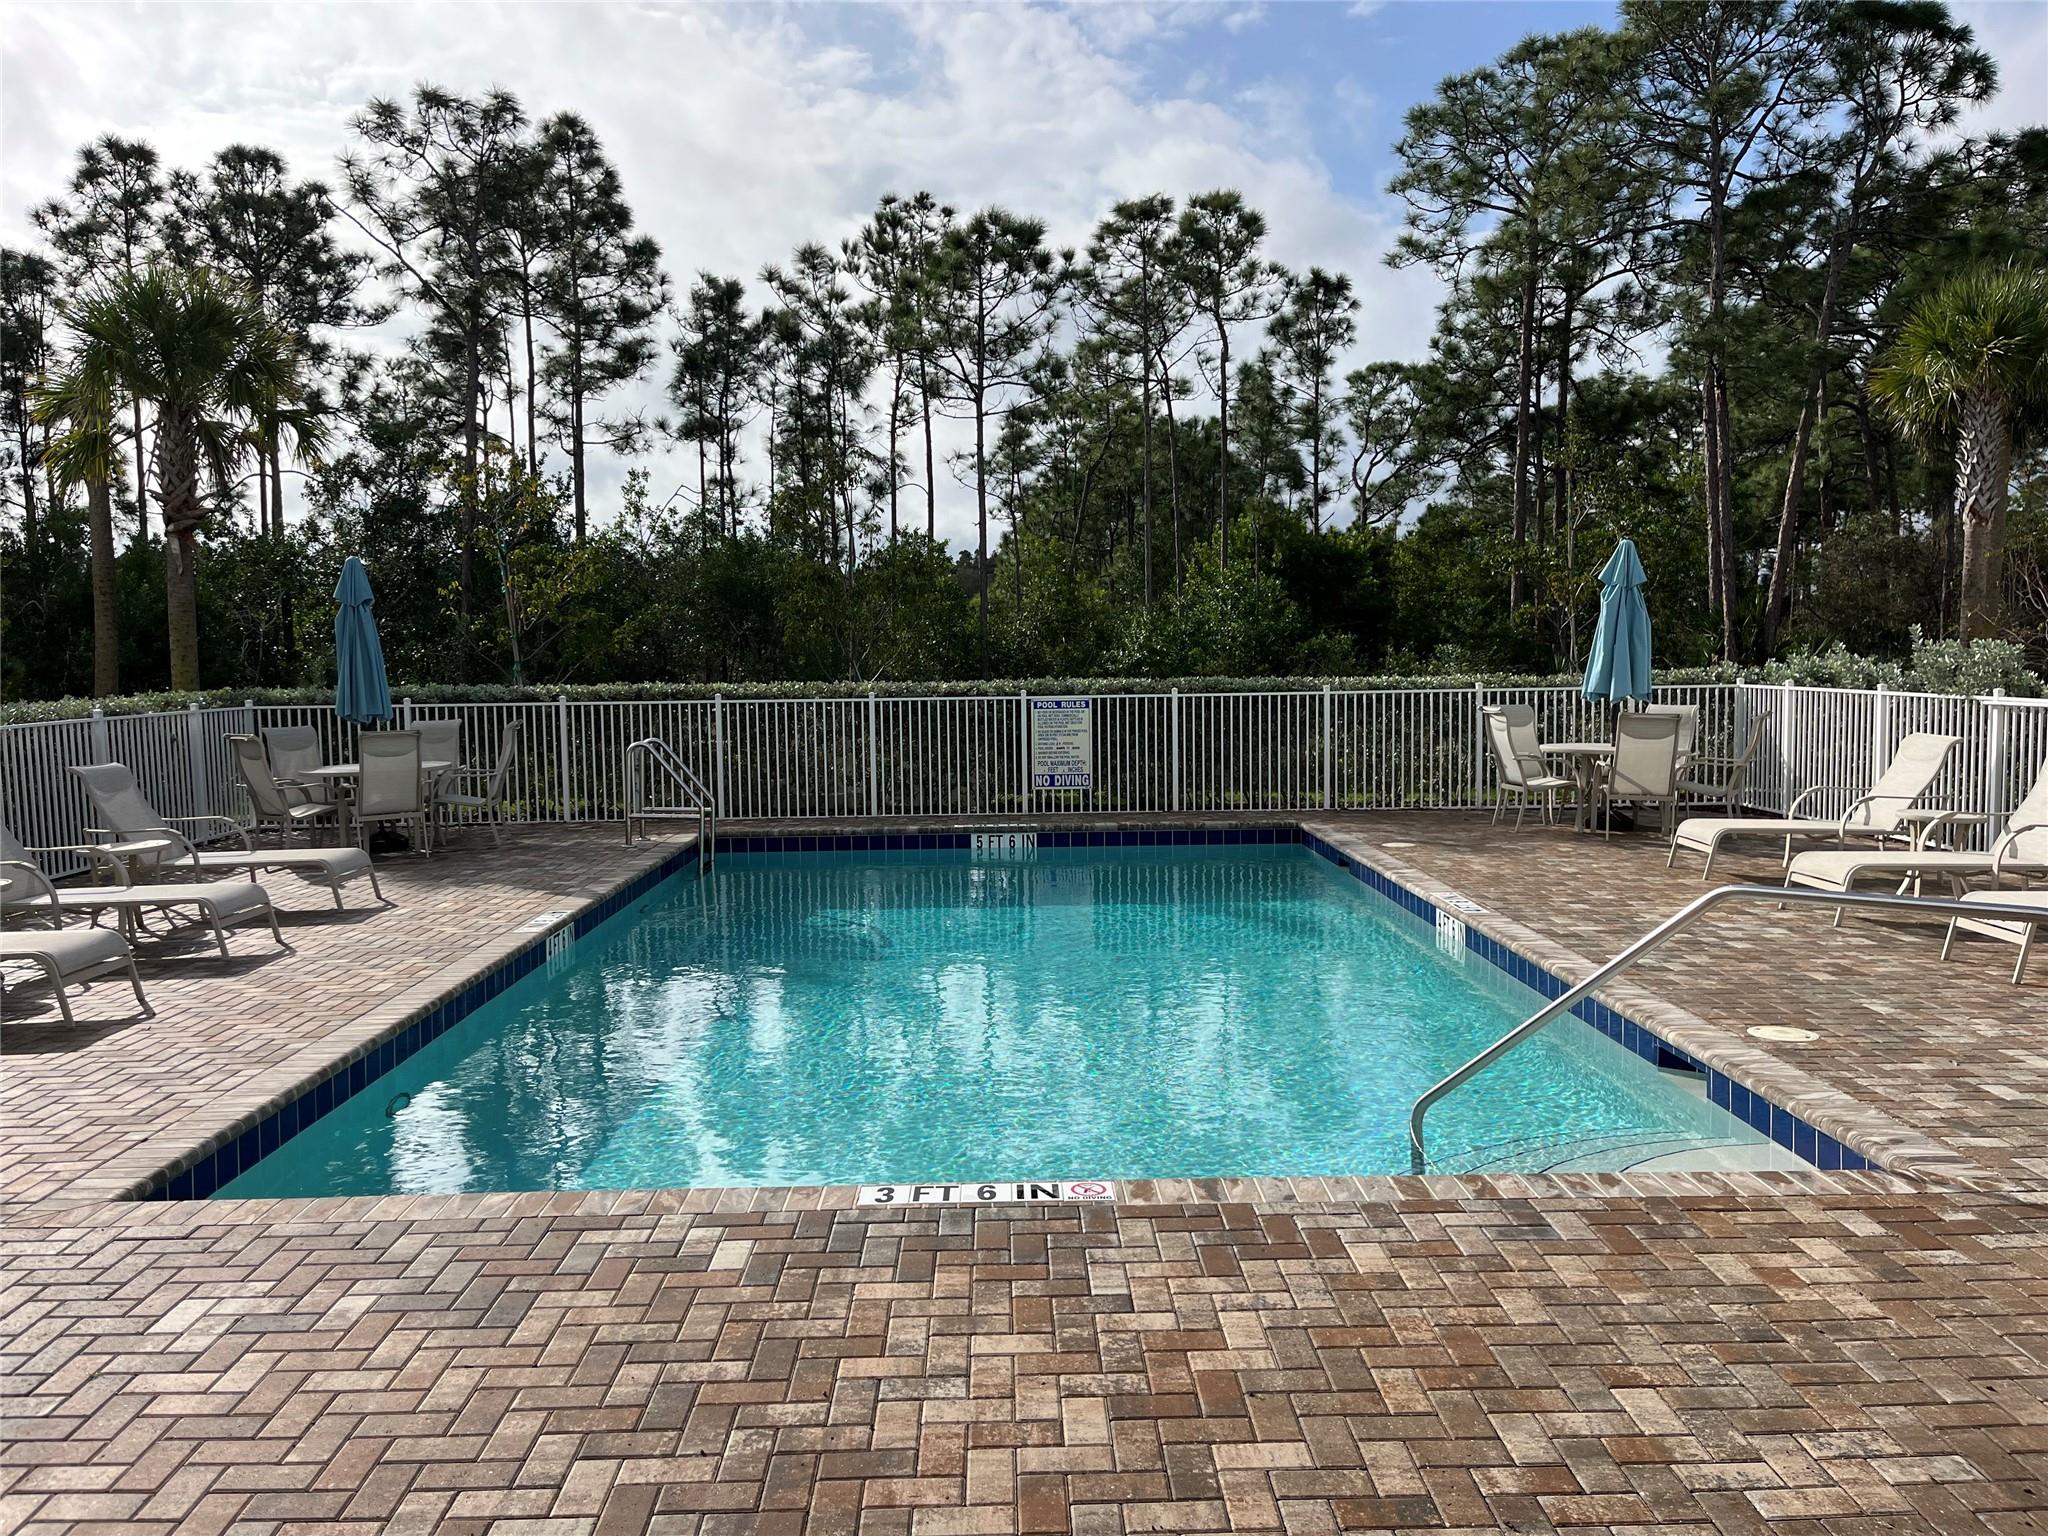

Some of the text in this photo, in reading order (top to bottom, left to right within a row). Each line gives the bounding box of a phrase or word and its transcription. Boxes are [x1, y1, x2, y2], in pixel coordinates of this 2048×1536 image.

[1037, 700, 1086, 709] POOL RULES
[1036, 775, 1089, 786] NO DIVING
[976, 834, 1035, 848] 5 FT 6 IN
[874, 1183, 1060, 1203] 3 FT 6 IN
